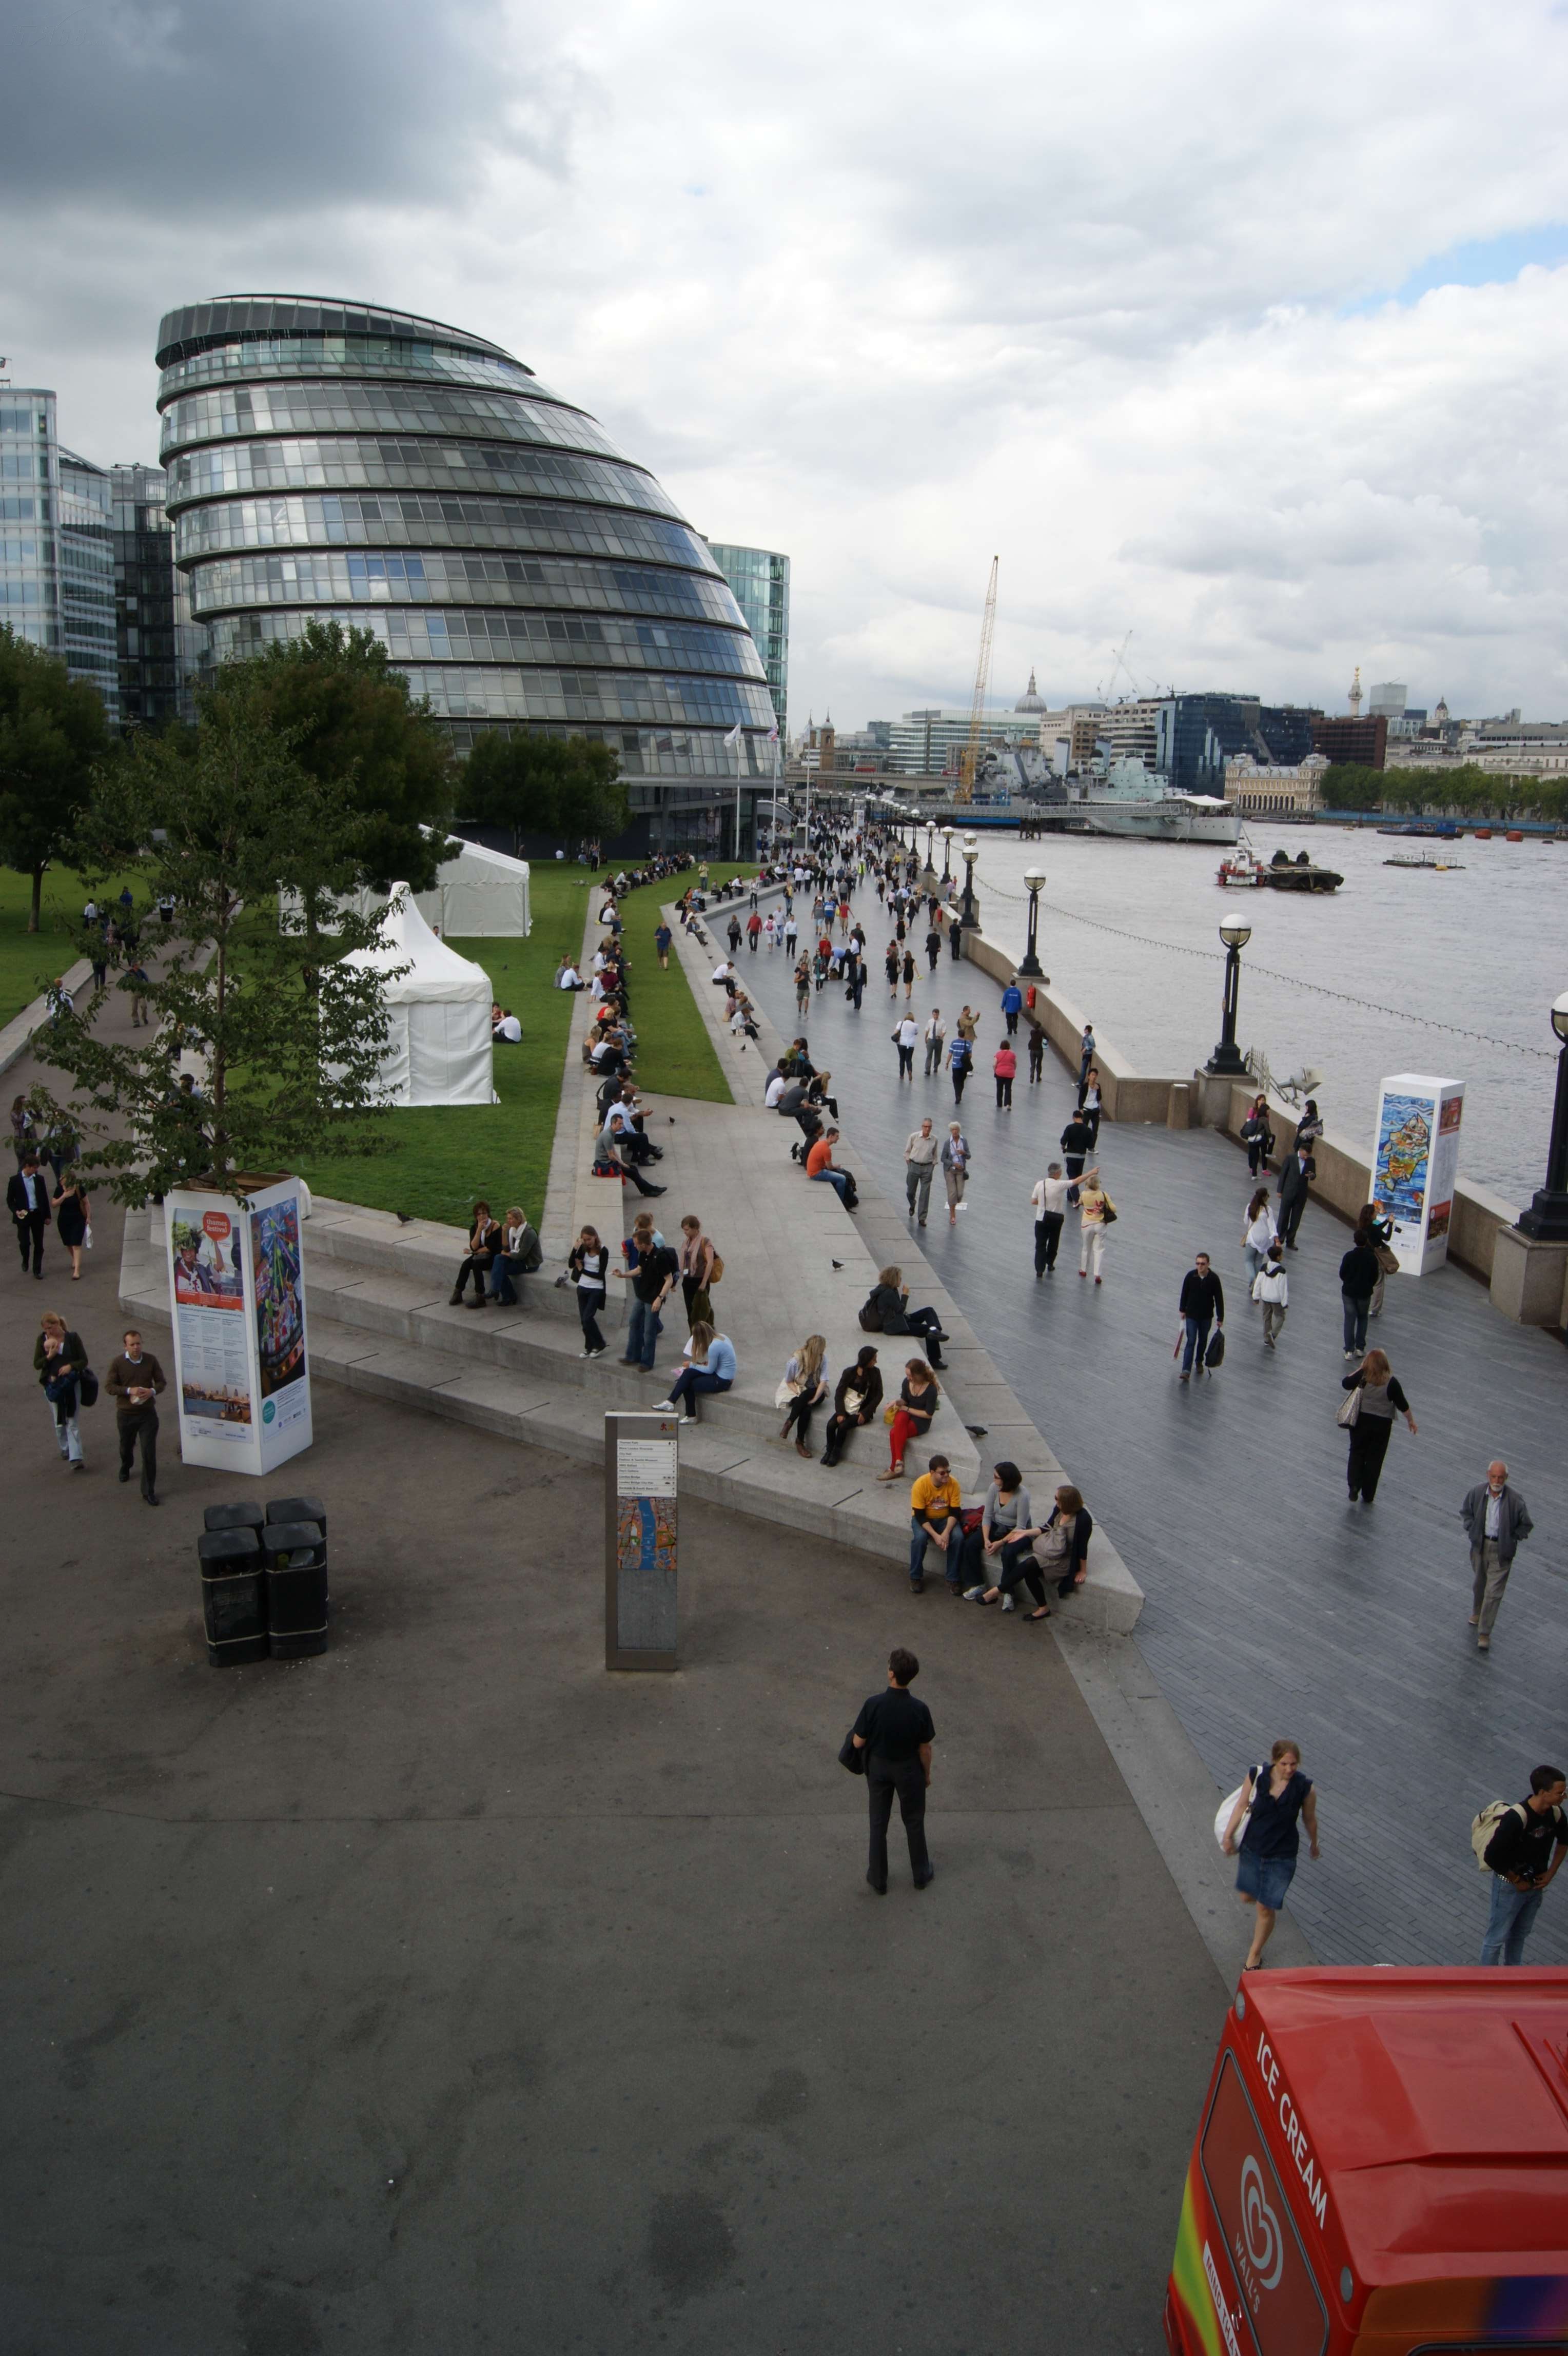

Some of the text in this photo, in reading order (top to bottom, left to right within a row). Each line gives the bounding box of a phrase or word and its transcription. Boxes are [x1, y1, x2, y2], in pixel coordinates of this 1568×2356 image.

[207, 1225, 227, 1233] festival
[1257, 2031, 1327, 2230] ICE CREAM
[1206, 2255, 1222, 2309] MIND
[1236, 2232, 1260, 2314] WALL'S
